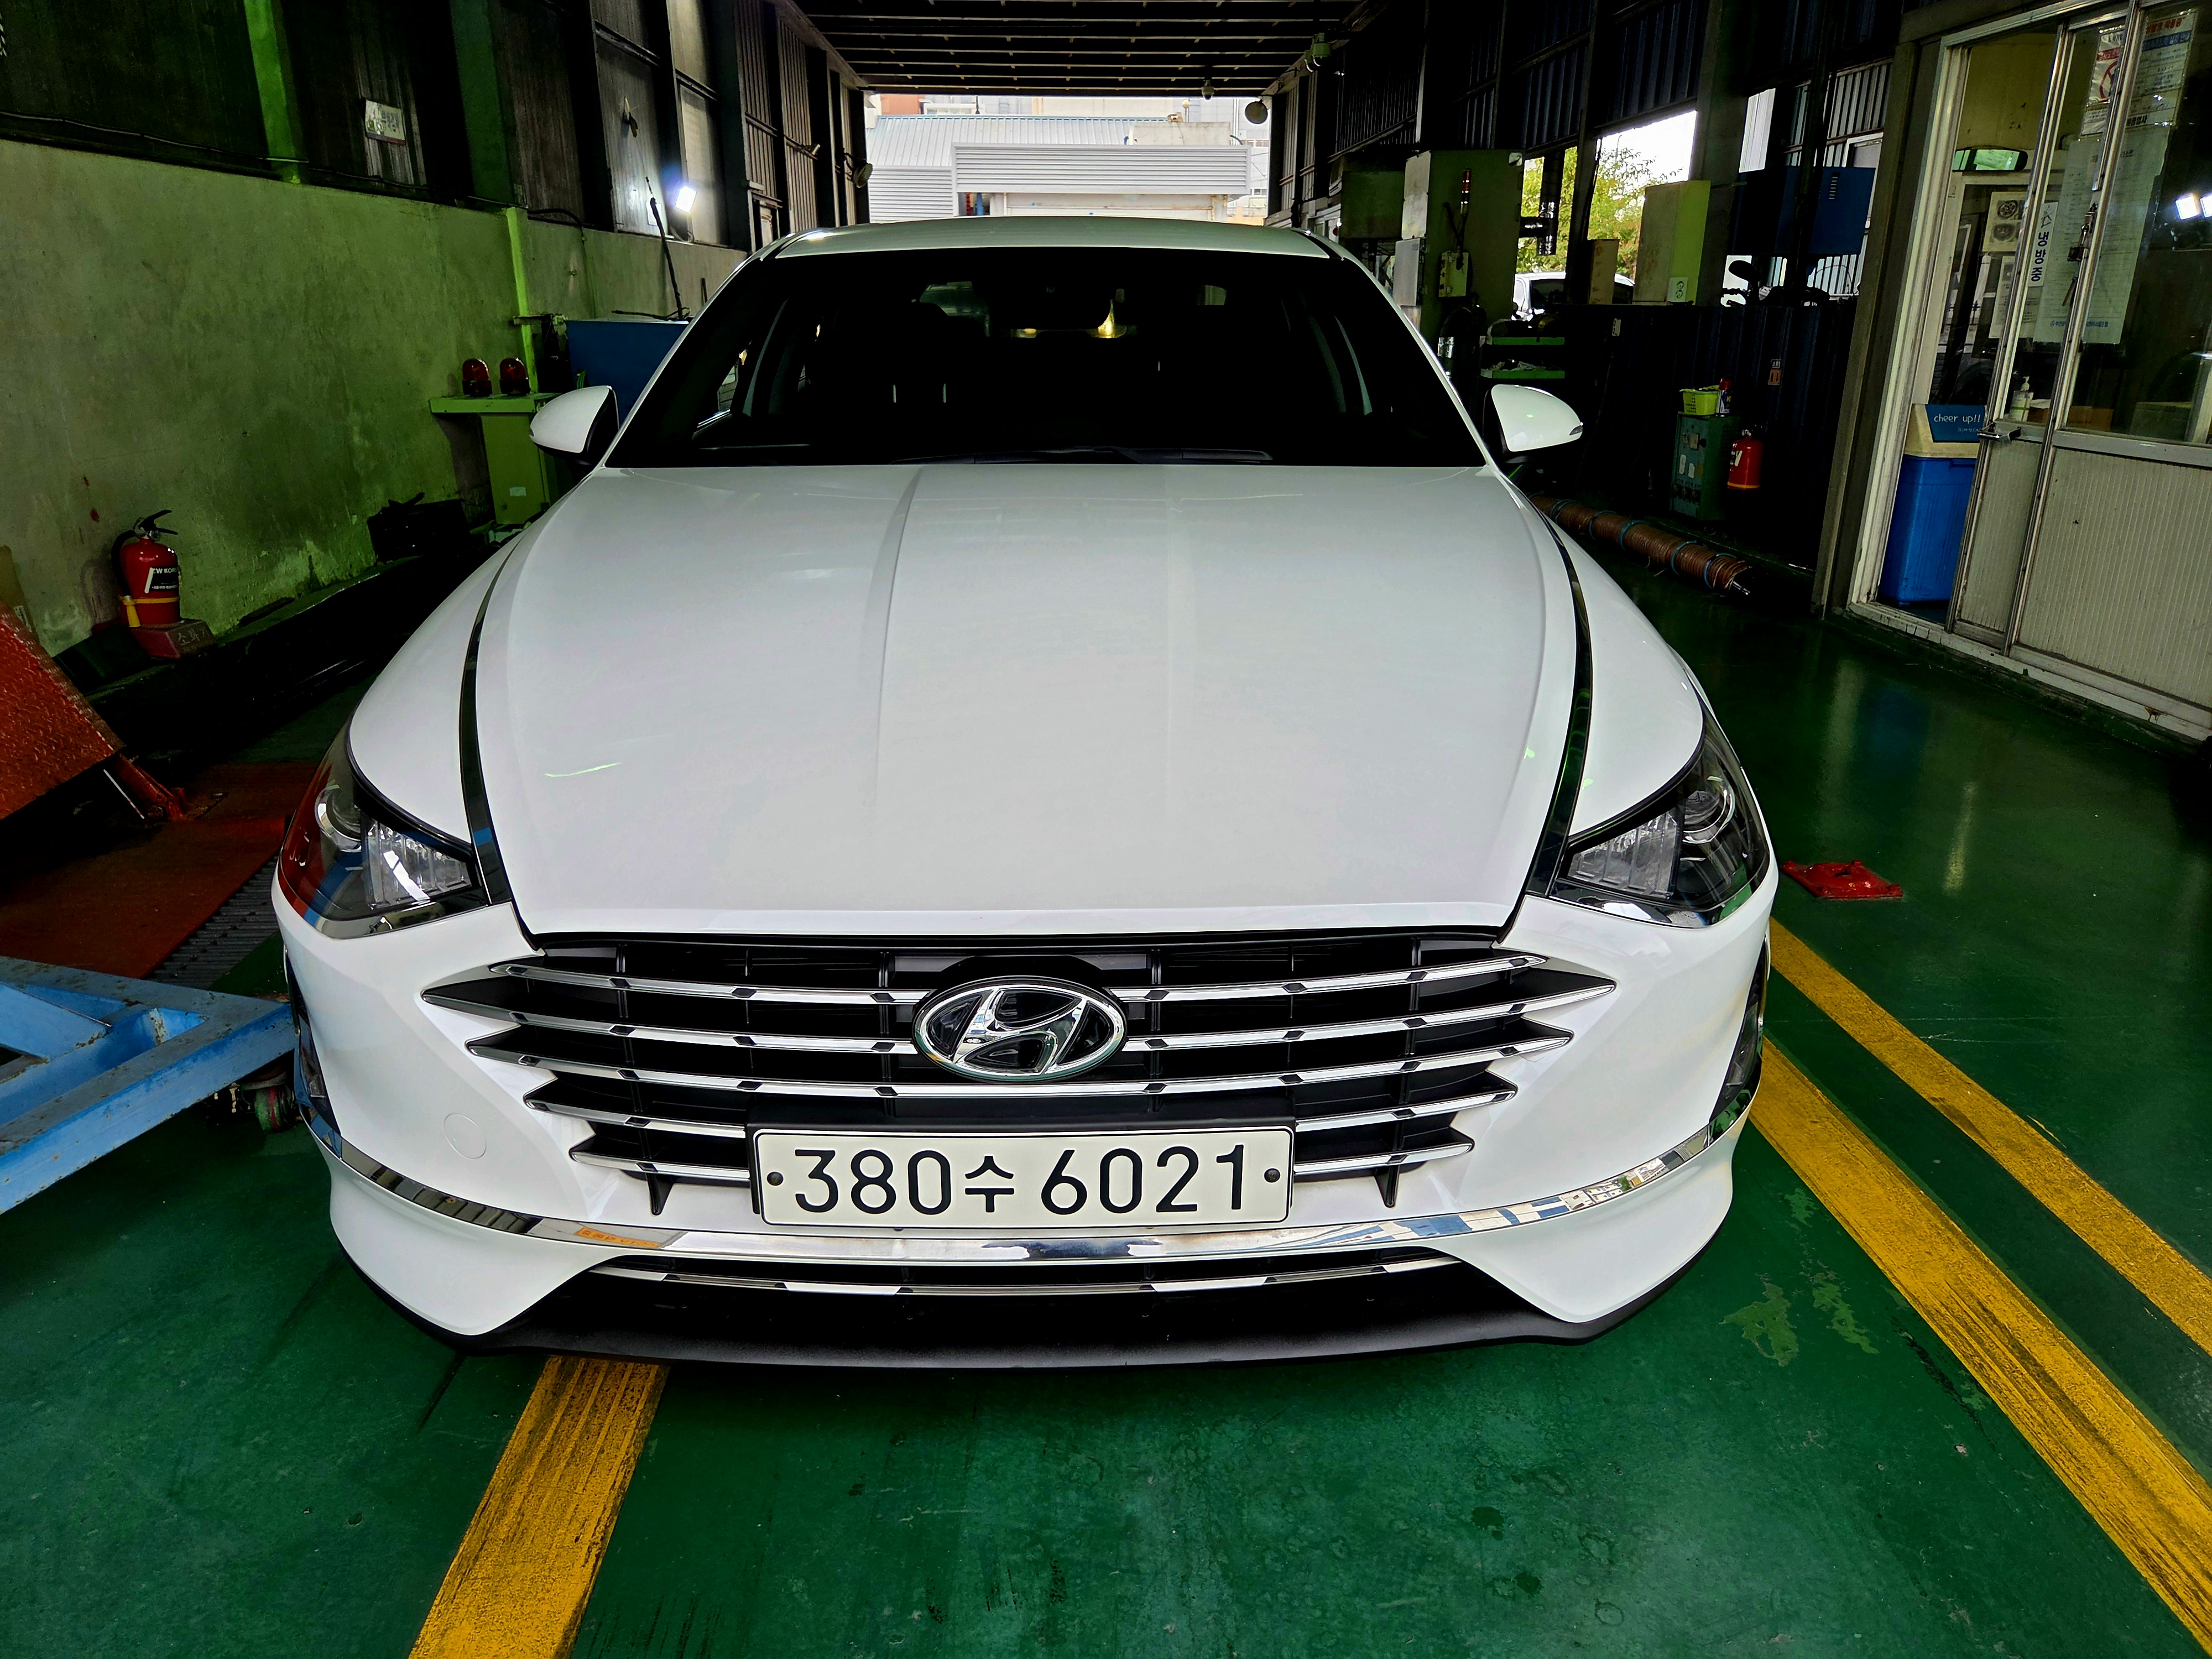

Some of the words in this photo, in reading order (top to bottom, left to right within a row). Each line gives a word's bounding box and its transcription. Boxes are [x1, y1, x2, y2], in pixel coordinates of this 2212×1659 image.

[2031, 231, 2049, 282] 냉방중
[1933, 413, 1959, 422] cheer
[1962, 414, 1981, 424] up!!
[794, 1148, 1015, 1215] 380수
[1040, 1144, 1245, 1216] 6021
